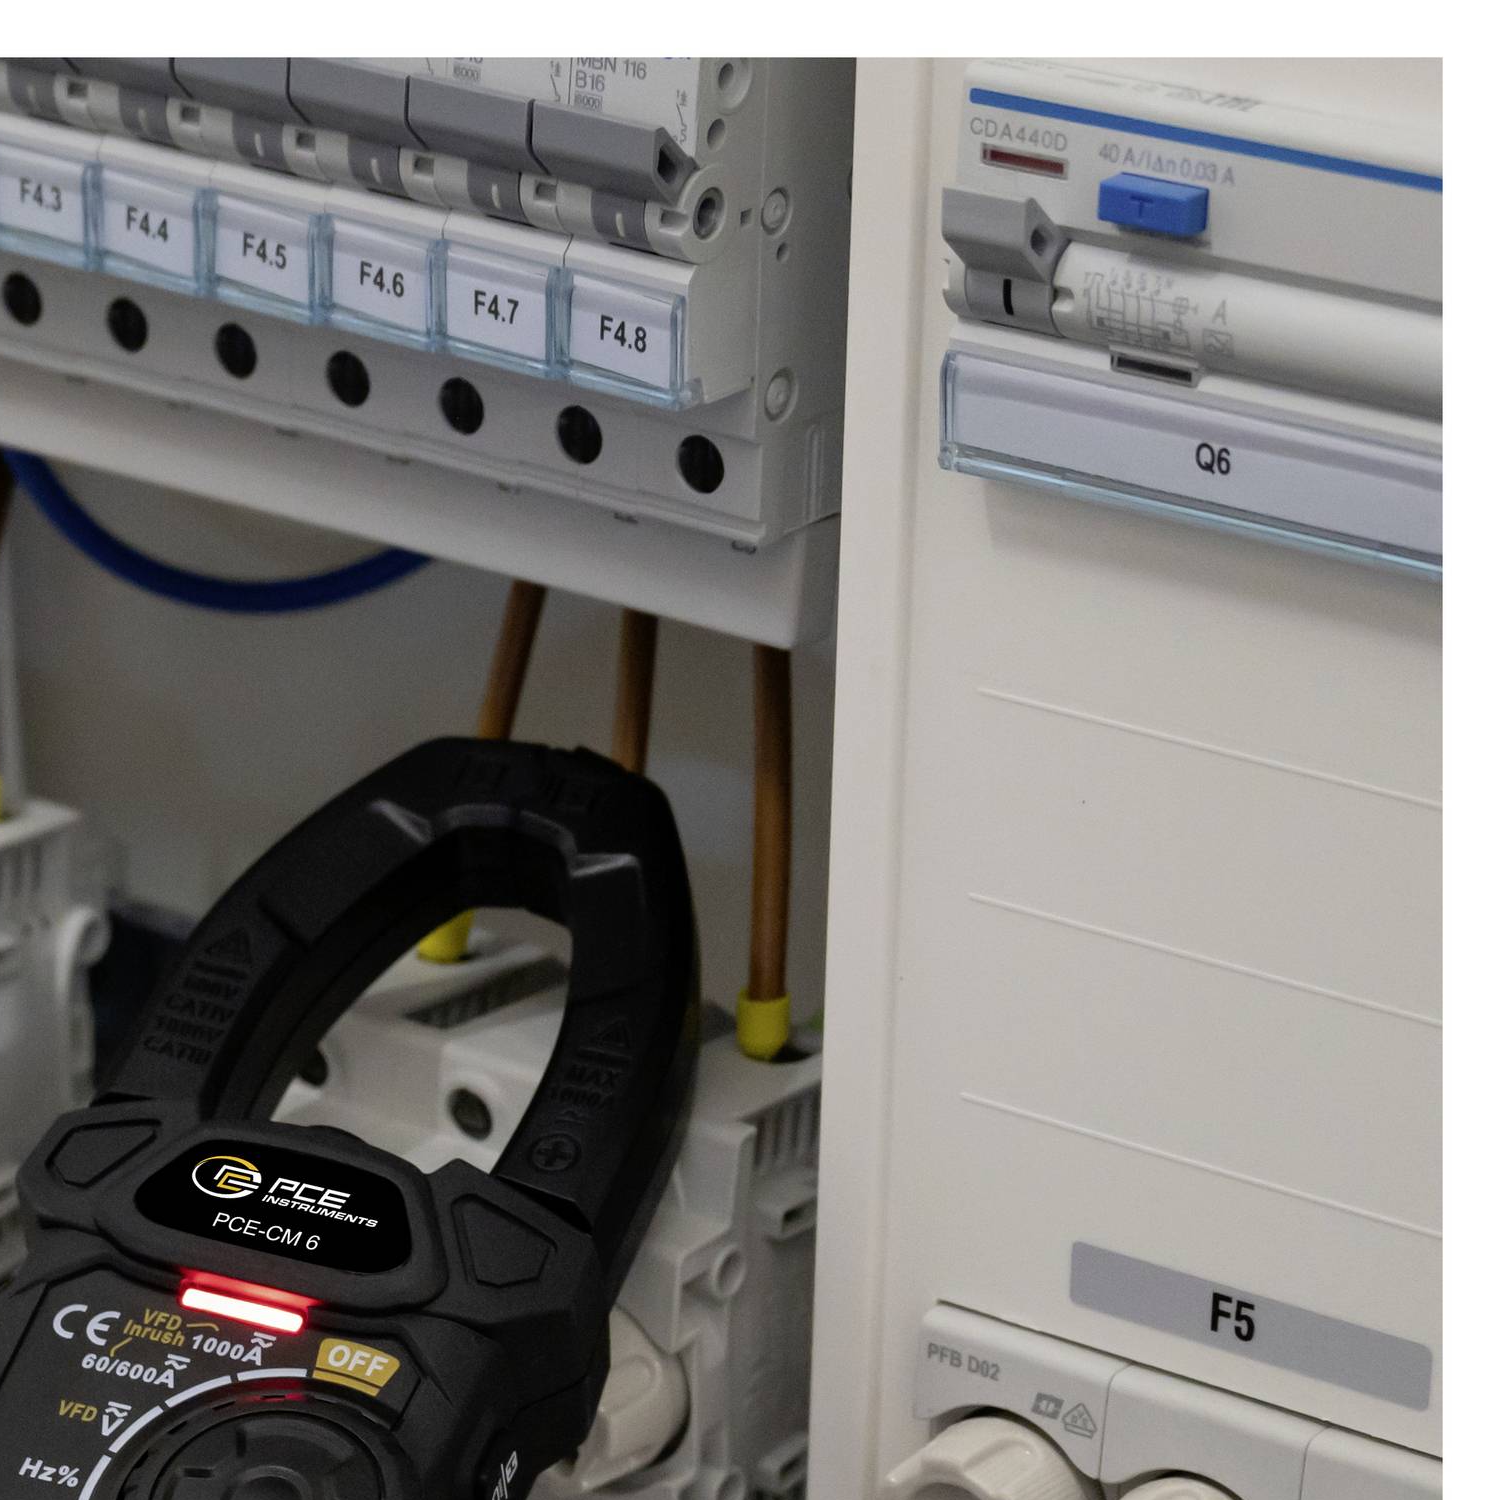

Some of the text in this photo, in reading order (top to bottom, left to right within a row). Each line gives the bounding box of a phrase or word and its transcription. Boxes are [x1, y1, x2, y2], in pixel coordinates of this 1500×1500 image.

[575, 69, 606, 92] B16
[623, 59, 648, 80] 116
[969, 116, 1068, 152] CDA440D
[20, 177, 63, 213] F4.3
[126, 207, 170, 243] F4.4
[242, 232, 288, 271] F4.5
[358, 262, 405, 300] F4.6
[473, 289, 520, 327] F4.7
[599, 315, 648, 355] F4.8
[1195, 443, 1232, 476] Q6
[261, 1194, 379, 1228] INSTRUMENTS
[268, 1177, 351, 1210] PCE
[212, 1212, 321, 1250] PCE-CM 6
[123, 1319, 185, 1347] Inrush
[143, 1308, 182, 1332] VFD
[1209, 1291, 1256, 1342] F5
[192, 1333, 263, 1366] 1000A
[327, 1344, 390, 1377] OFF
[926, 1342, 1000, 1382] PFB D02
[81, 1353, 176, 1389] 60/600A
[57, 1400, 97, 1422] VFD
[19, 1457, 79, 1488] Hz%
